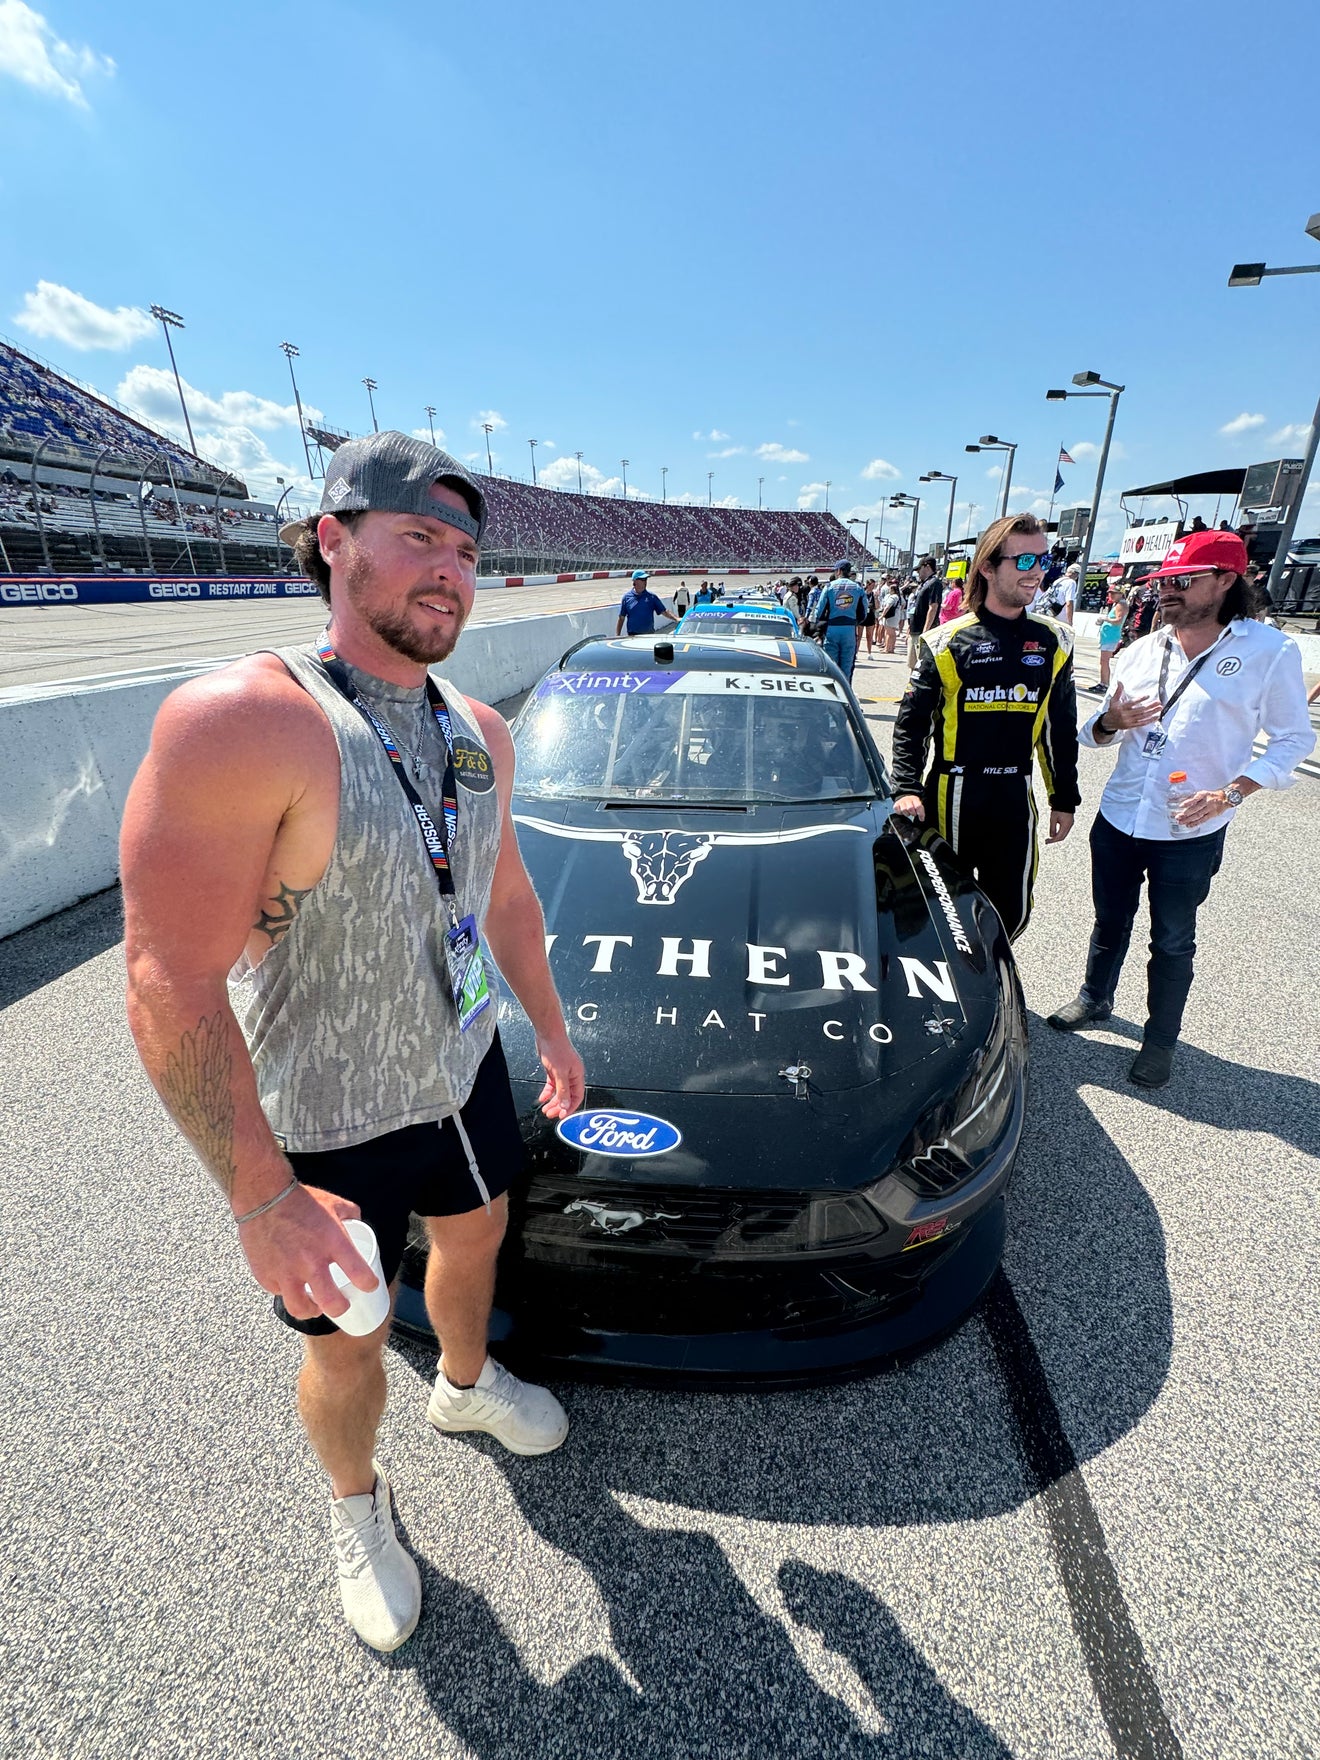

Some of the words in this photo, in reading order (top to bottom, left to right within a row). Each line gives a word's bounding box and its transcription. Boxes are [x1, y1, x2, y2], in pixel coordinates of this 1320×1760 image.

[1144, 533, 1173, 551] HEALTH
[1, 584, 79, 601] GEICO
[149, 583, 200, 597] GEICO
[209, 584, 251, 595] RESTART
[253, 583, 277, 594] ZONE
[558, 673, 651, 693] xfinity
[725, 678, 750, 690] K.
[761, 679, 814, 693] SIEG
[983, 767, 1003, 775] KYLE
[414, 804, 443, 853] NASCAR
[656, 1006, 767, 1032] HAT
[823, 1020, 893, 1044] CO
[579, 1114, 659, 1152] Ford
